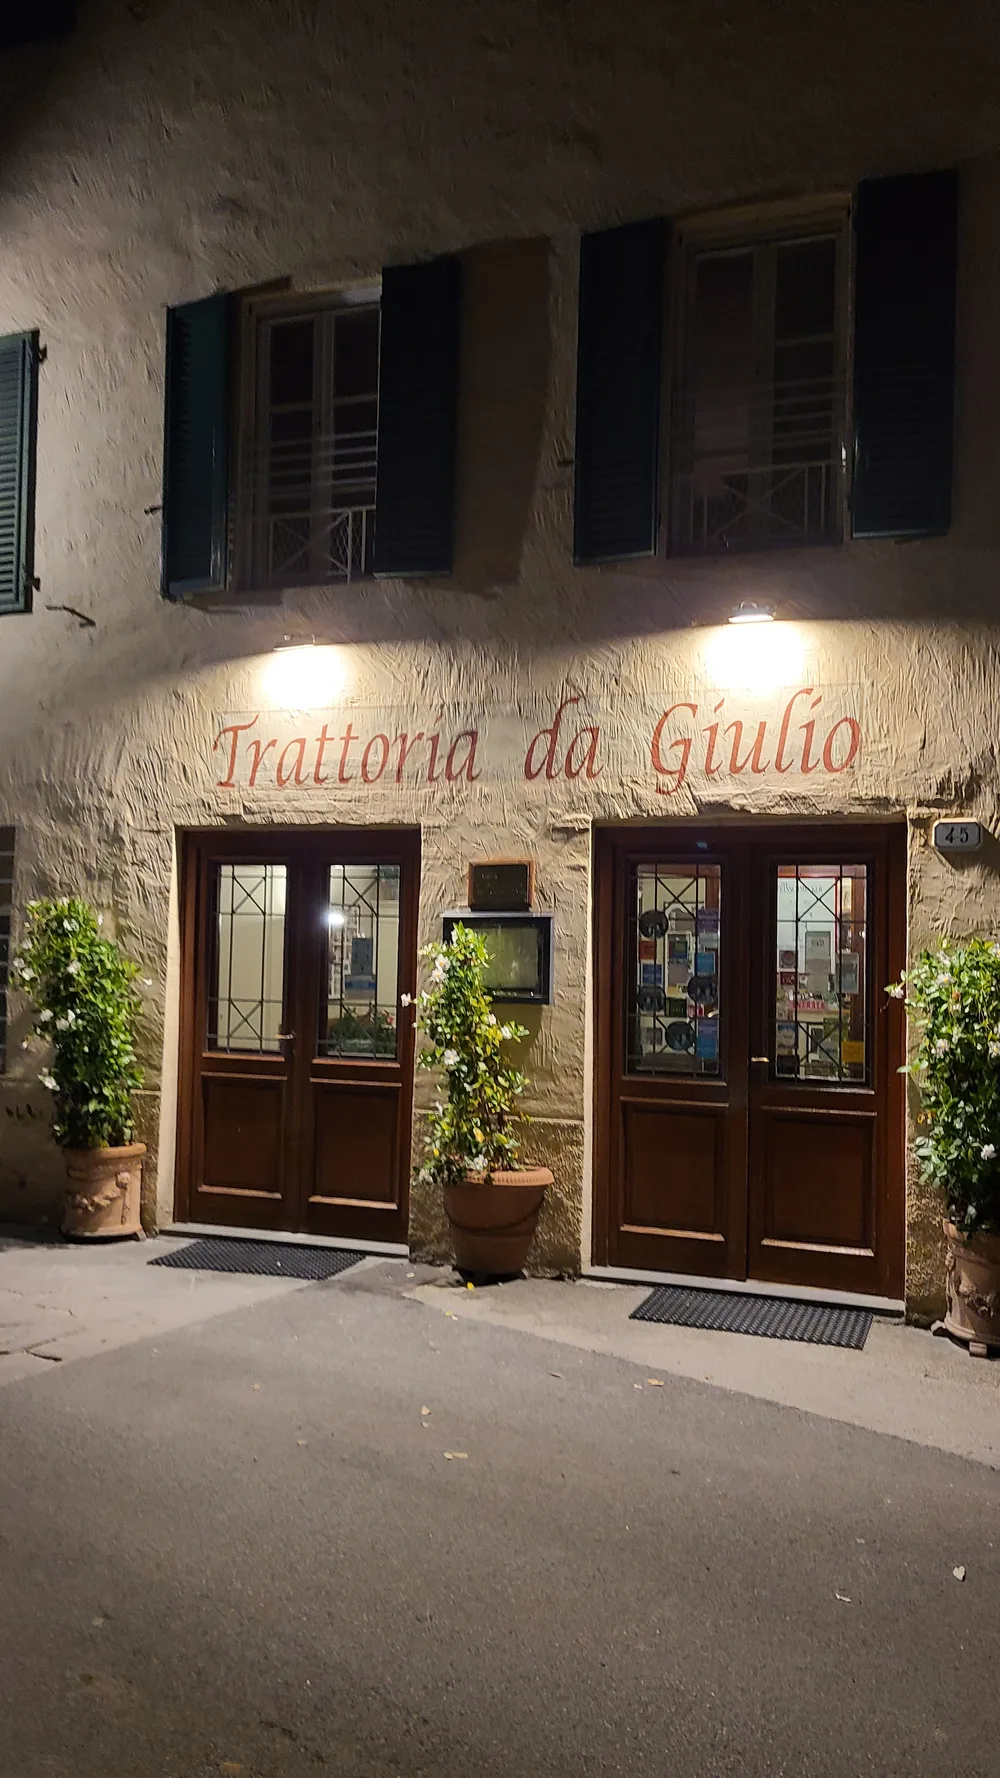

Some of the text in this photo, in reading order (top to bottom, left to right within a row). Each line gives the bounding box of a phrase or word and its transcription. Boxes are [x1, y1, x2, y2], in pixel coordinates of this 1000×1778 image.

[213, 688, 862, 795] Trattoria da Giulio
[944, 826, 970, 844] 45
